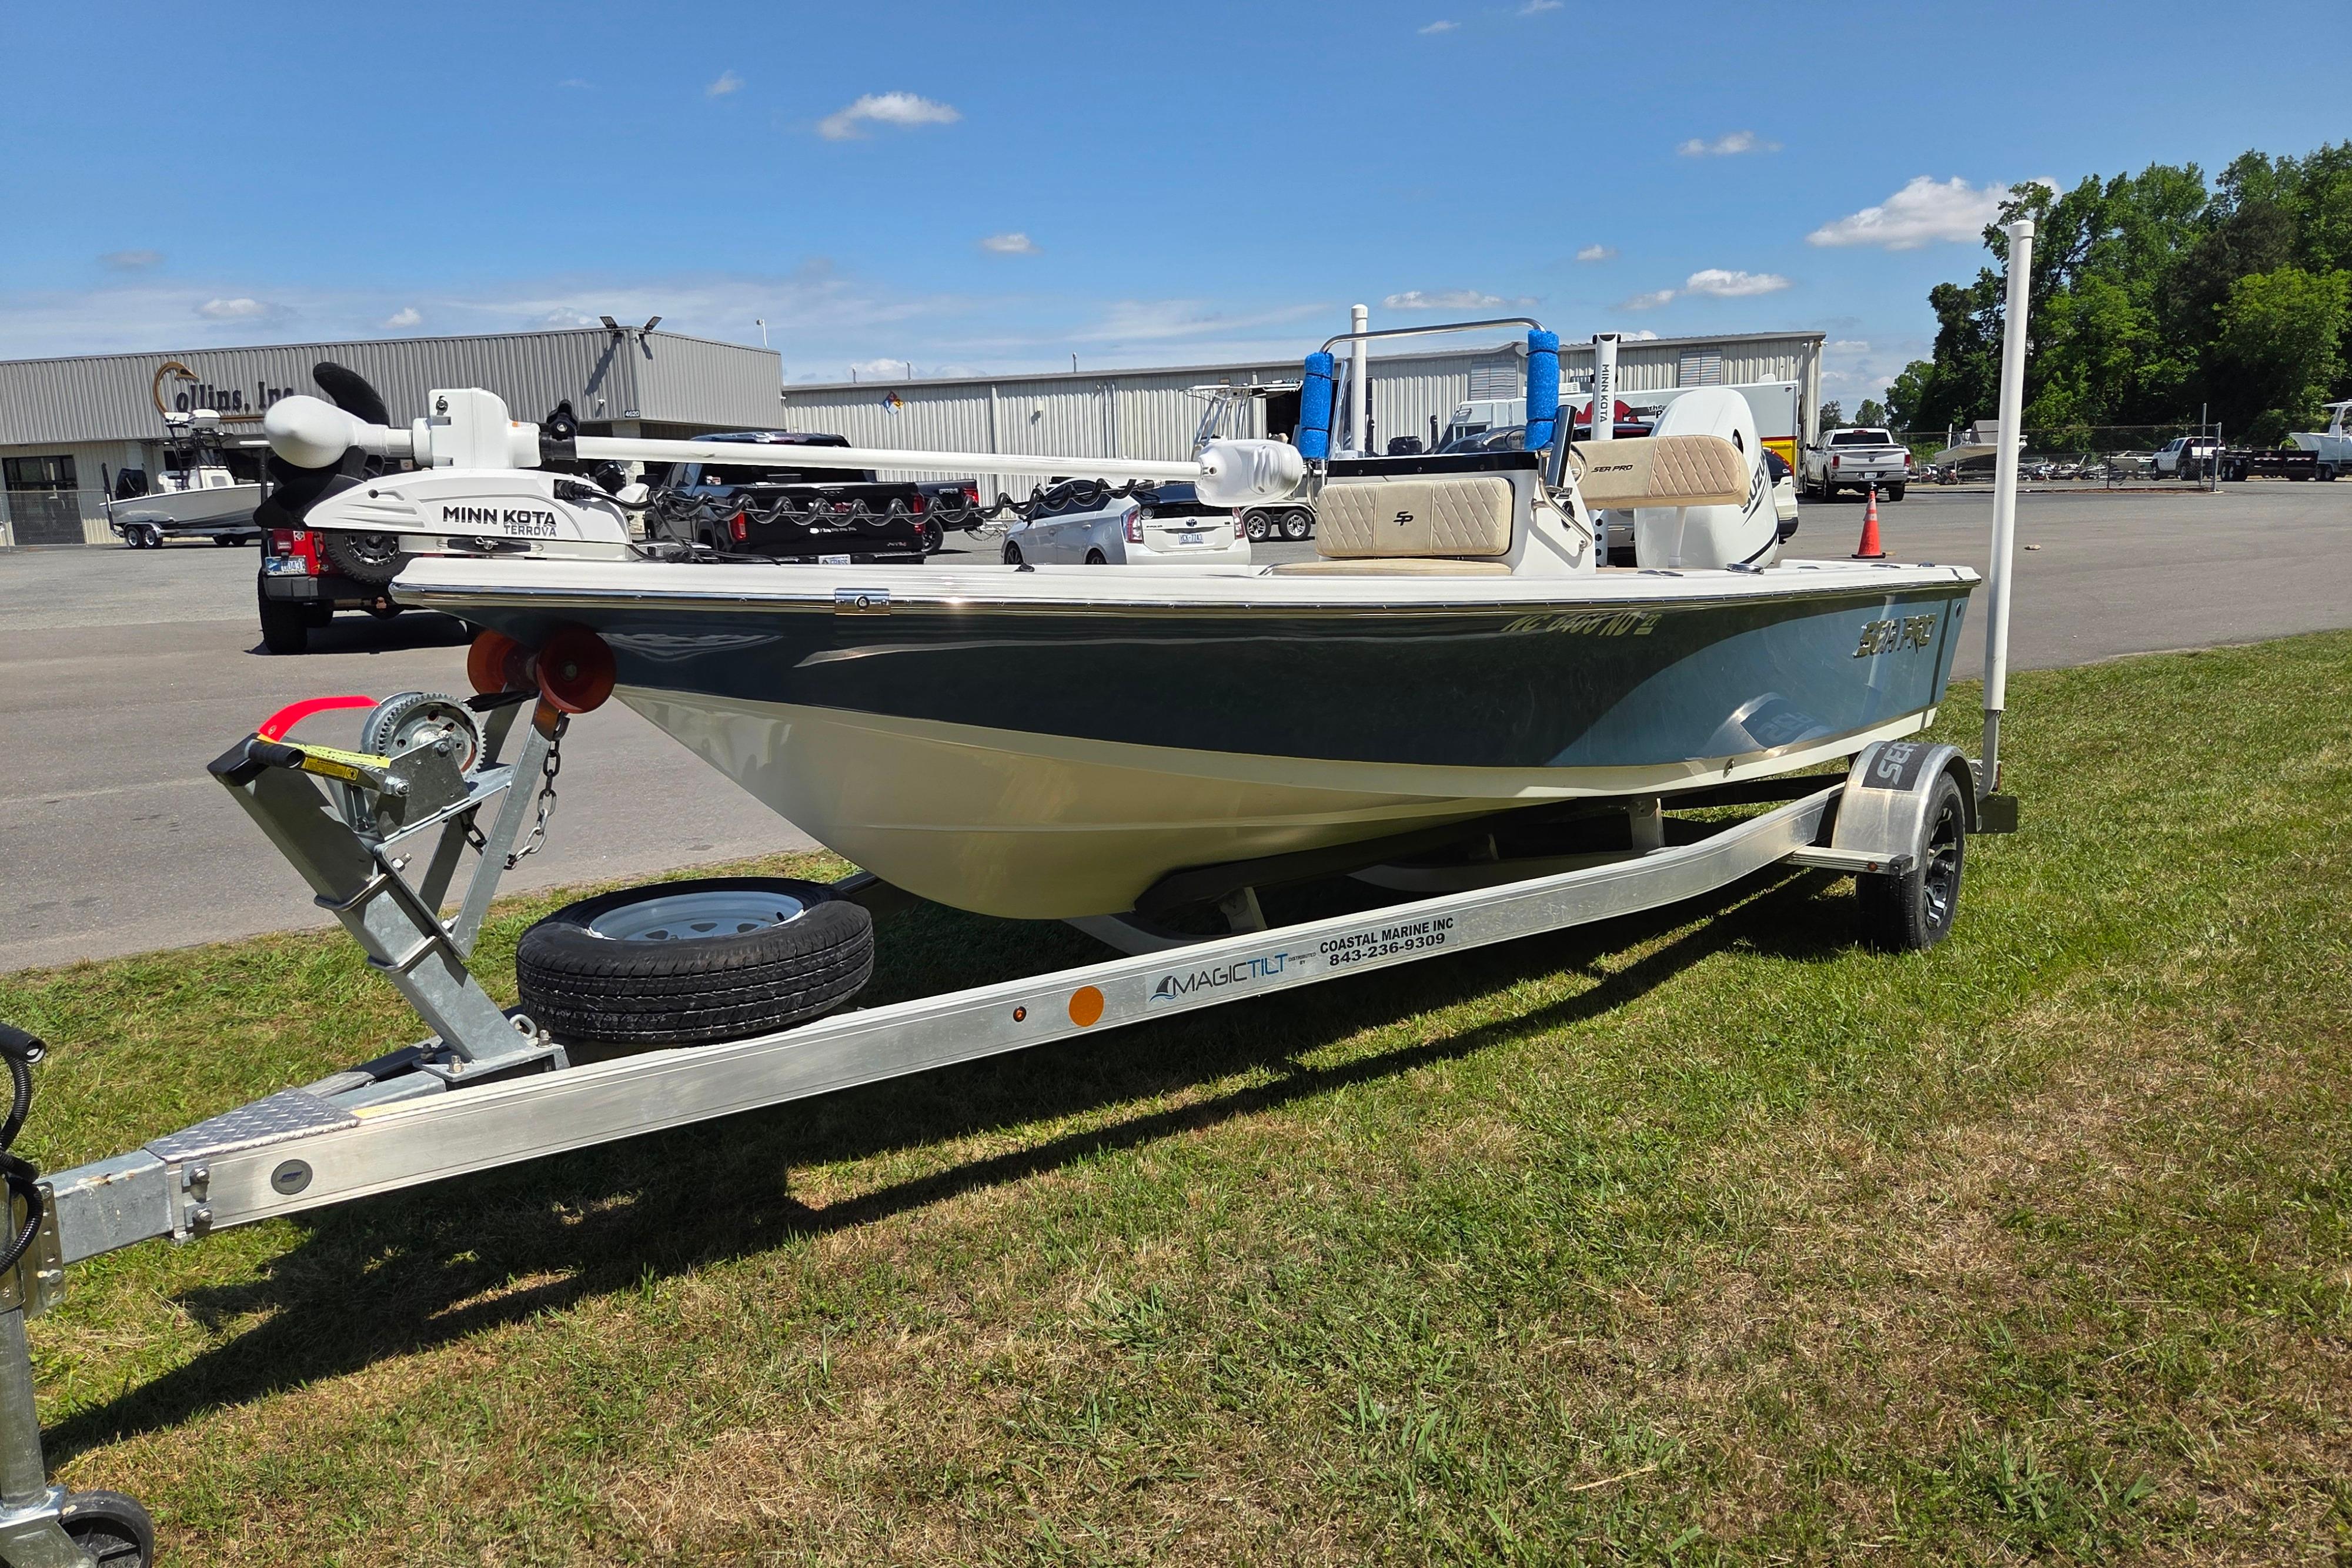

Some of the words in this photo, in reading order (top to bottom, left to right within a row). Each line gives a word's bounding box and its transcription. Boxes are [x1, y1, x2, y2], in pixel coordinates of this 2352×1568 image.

[1601, 364, 1610, 392] MINN
[1600, 394, 1608, 423] KOTA
[443, 506, 497, 524] MINN
[503, 509, 557, 527] KOTA
[503, 525, 557, 537] TERROVA
[1500, 613, 1553, 633] NC
[1598, 611, 1641, 636] ND
[1853, 618, 1900, 658] SEA
[1896, 613, 1936, 654] PRO
[1319, 932, 1378, 954] COASTAL
[1382, 921, 1429, 941] MARINE
[1433, 917, 1454, 931] INC
[1329, 932, 1446, 966] 843-236-9309
[1288, 952, 1317, 962] DISTRIBUTED
[1172, 953, 1288, 996] MAGICTILT
